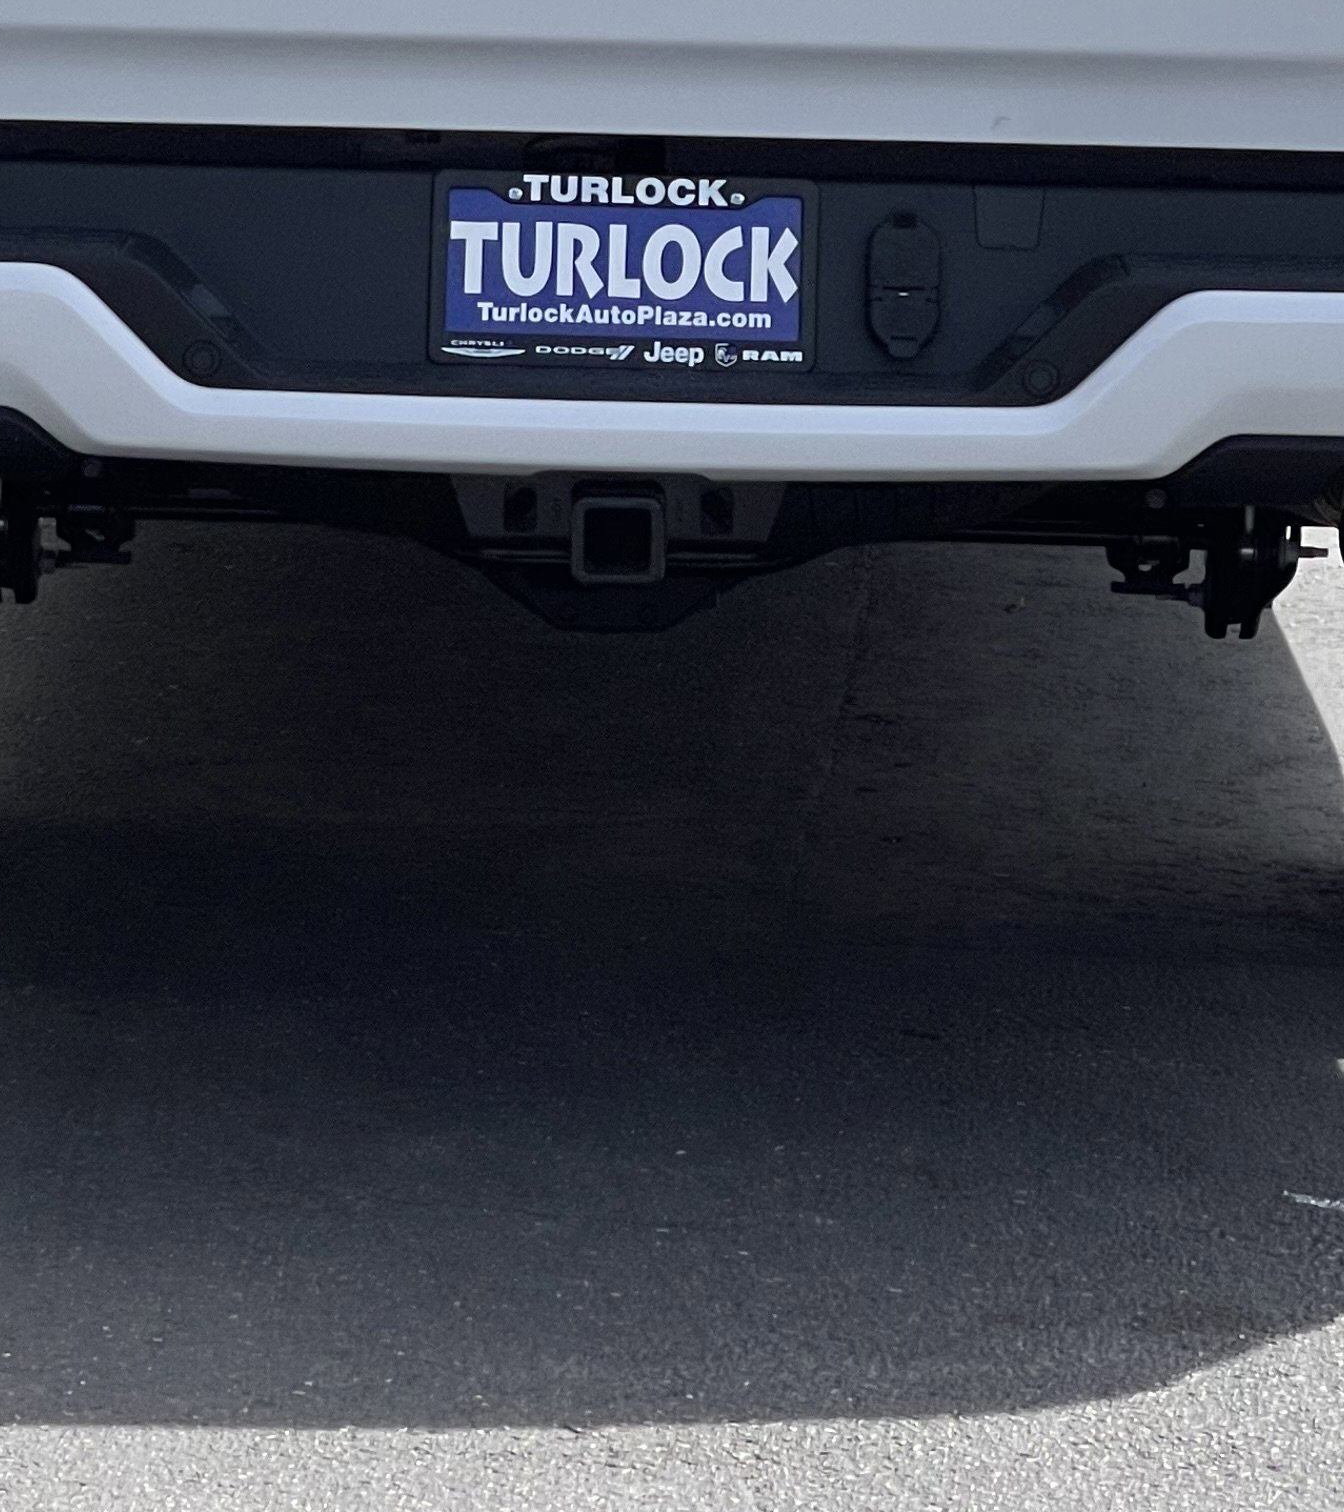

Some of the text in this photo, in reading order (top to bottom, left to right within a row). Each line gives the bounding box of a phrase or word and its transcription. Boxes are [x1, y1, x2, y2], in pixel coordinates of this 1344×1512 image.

[522, 174, 729, 207] TURLOCK
[449, 220, 799, 304] TURLOCK
[476, 301, 772, 329] TurlockAutoPlaza.com
[643, 341, 705, 367] Jeep
[742, 349, 803, 362] RAM
